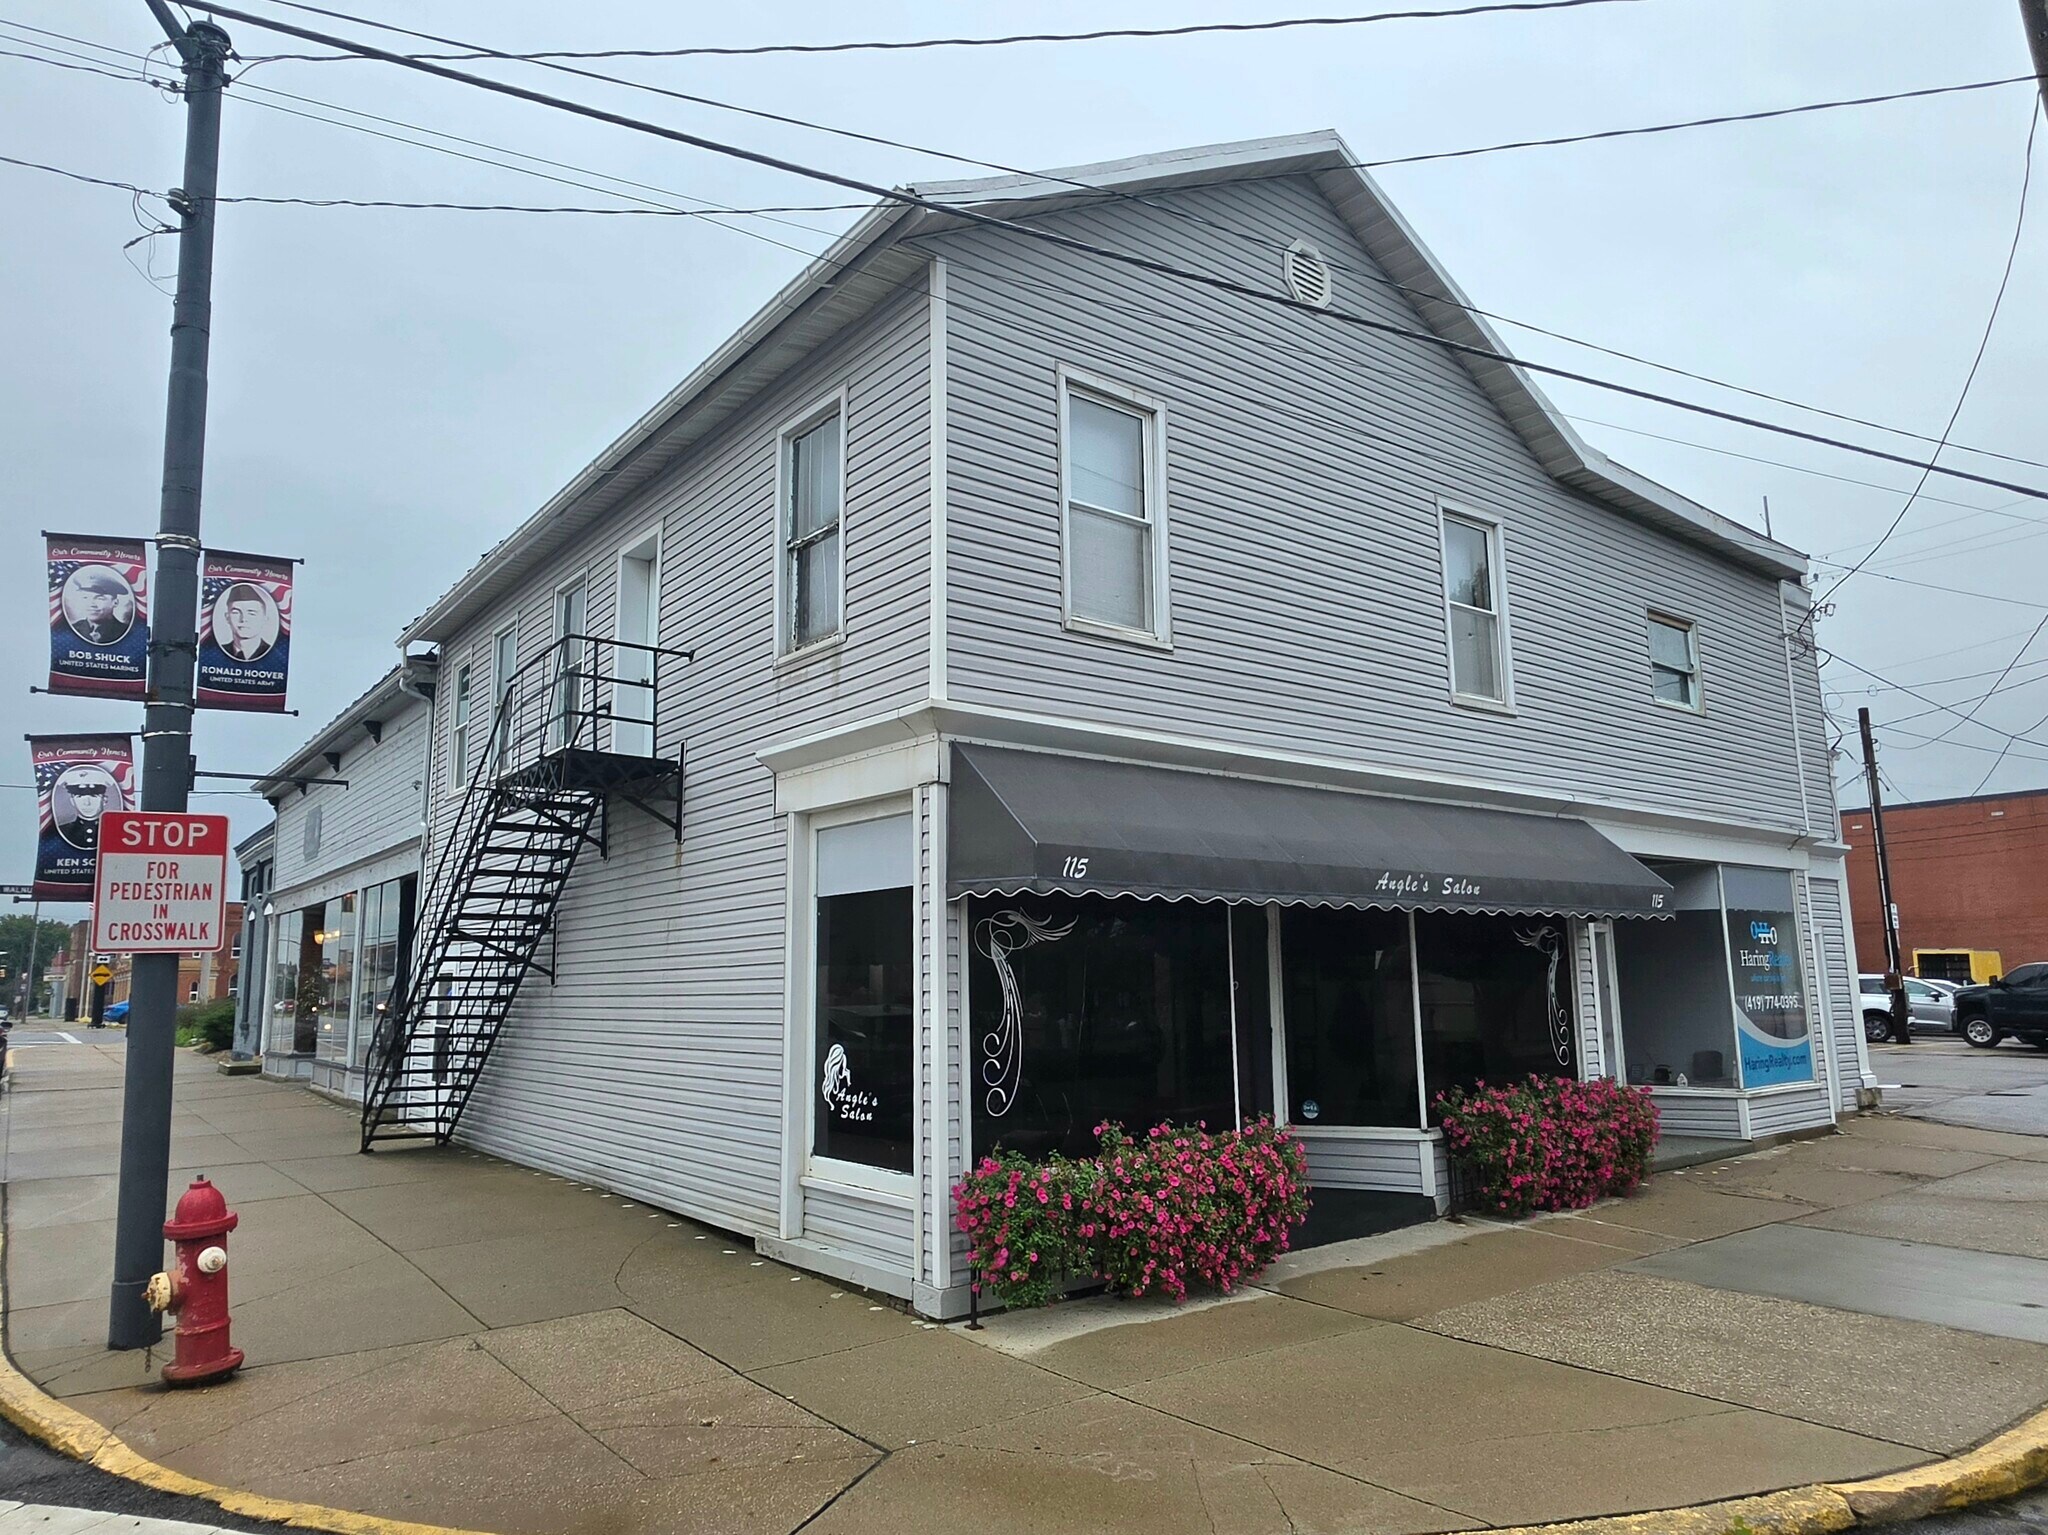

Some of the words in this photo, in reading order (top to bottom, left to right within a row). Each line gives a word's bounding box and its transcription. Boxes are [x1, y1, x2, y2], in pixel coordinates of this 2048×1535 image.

[70, 548, 112, 559] Community
[225, 565, 262, 577] Community
[69, 650, 92, 660] BOB
[94, 651, 131, 664] SHUCK
[59, 659, 85, 668] UNITED
[85, 662, 109, 670] STATES
[110, 664, 140, 672] MARINES
[201, 665, 242, 676] RONALD
[244, 670, 285, 680] HOOVER
[56, 747, 98, 757] Community
[101, 746, 128, 757] Honors
[121, 820, 209, 847] STOP
[57, 858, 80, 867] KEN
[146, 861, 179, 879] FOR
[1062, 855, 1090, 879] 115
[109, 882, 213, 901] PEDESTRIAN
[1375, 871, 1430, 897] Angle's
[1441, 877, 1481, 895] Salon
[1651, 893, 1664, 909] 115
[152, 903, 169, 919] IN
[108, 922, 210, 941] CROSSWALK
[836, 1087, 879, 1107] Angle's
[840, 1104, 873, 1121] Salon
